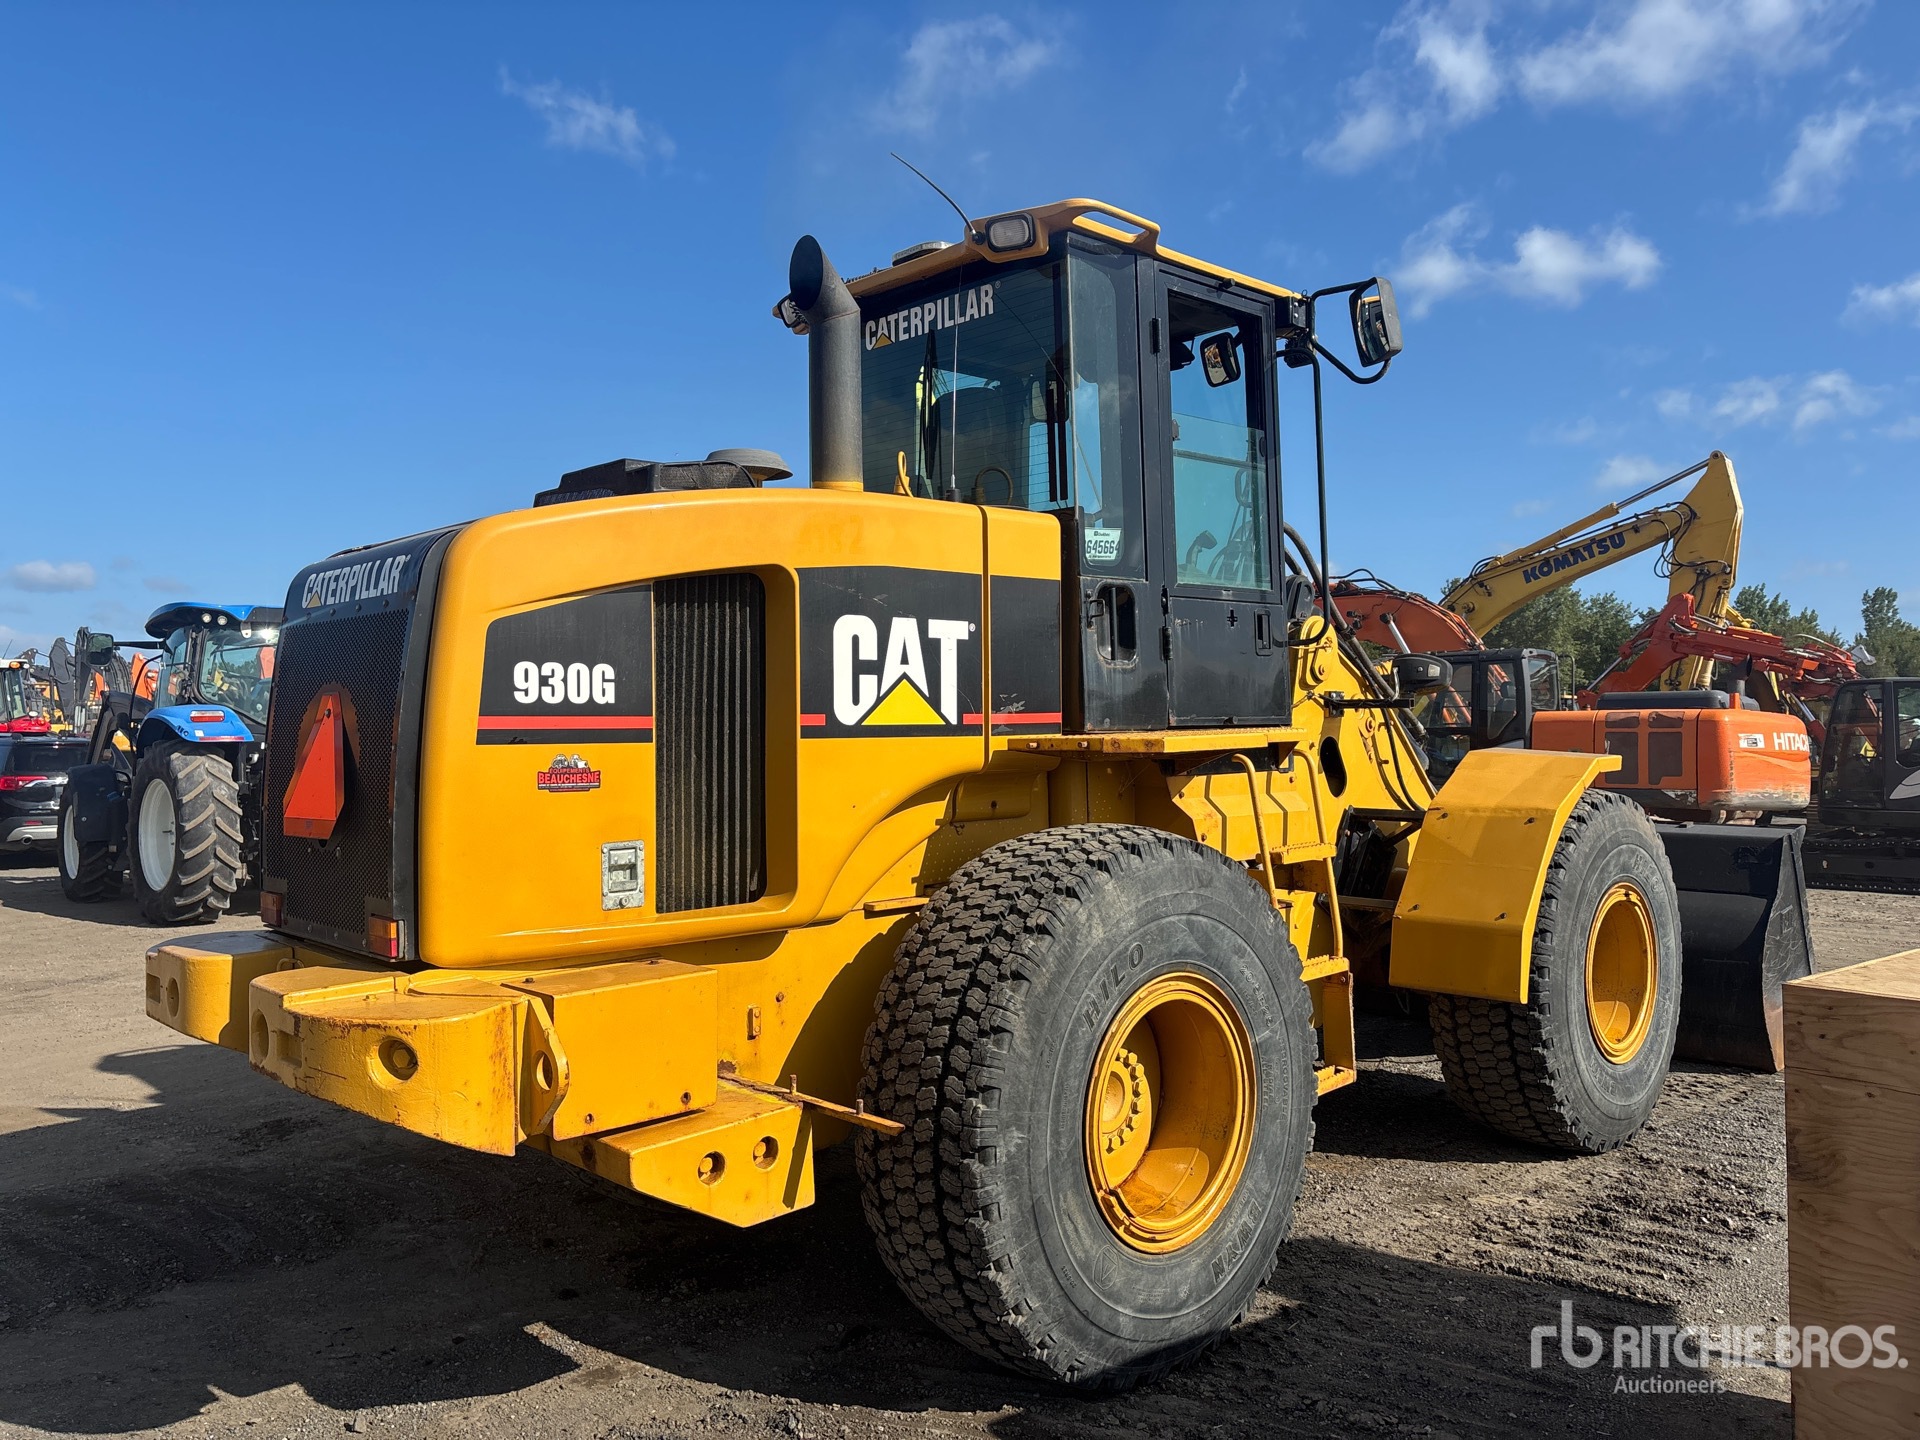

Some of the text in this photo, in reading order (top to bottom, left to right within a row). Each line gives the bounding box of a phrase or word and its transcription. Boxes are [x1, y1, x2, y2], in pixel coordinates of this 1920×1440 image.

[865, 284, 994, 351] CATERPILLAR
[302, 555, 406, 609] CATERPILLAR
[1522, 532, 1626, 584] KOMATSU
[513, 661, 616, 705] 930G
[833, 614, 969, 726] CAT
[1772, 732, 1810, 752] HITACH
[538, 771, 600, 784] BEAUCHESNE
[1082, 942, 1144, 1032] HILO
